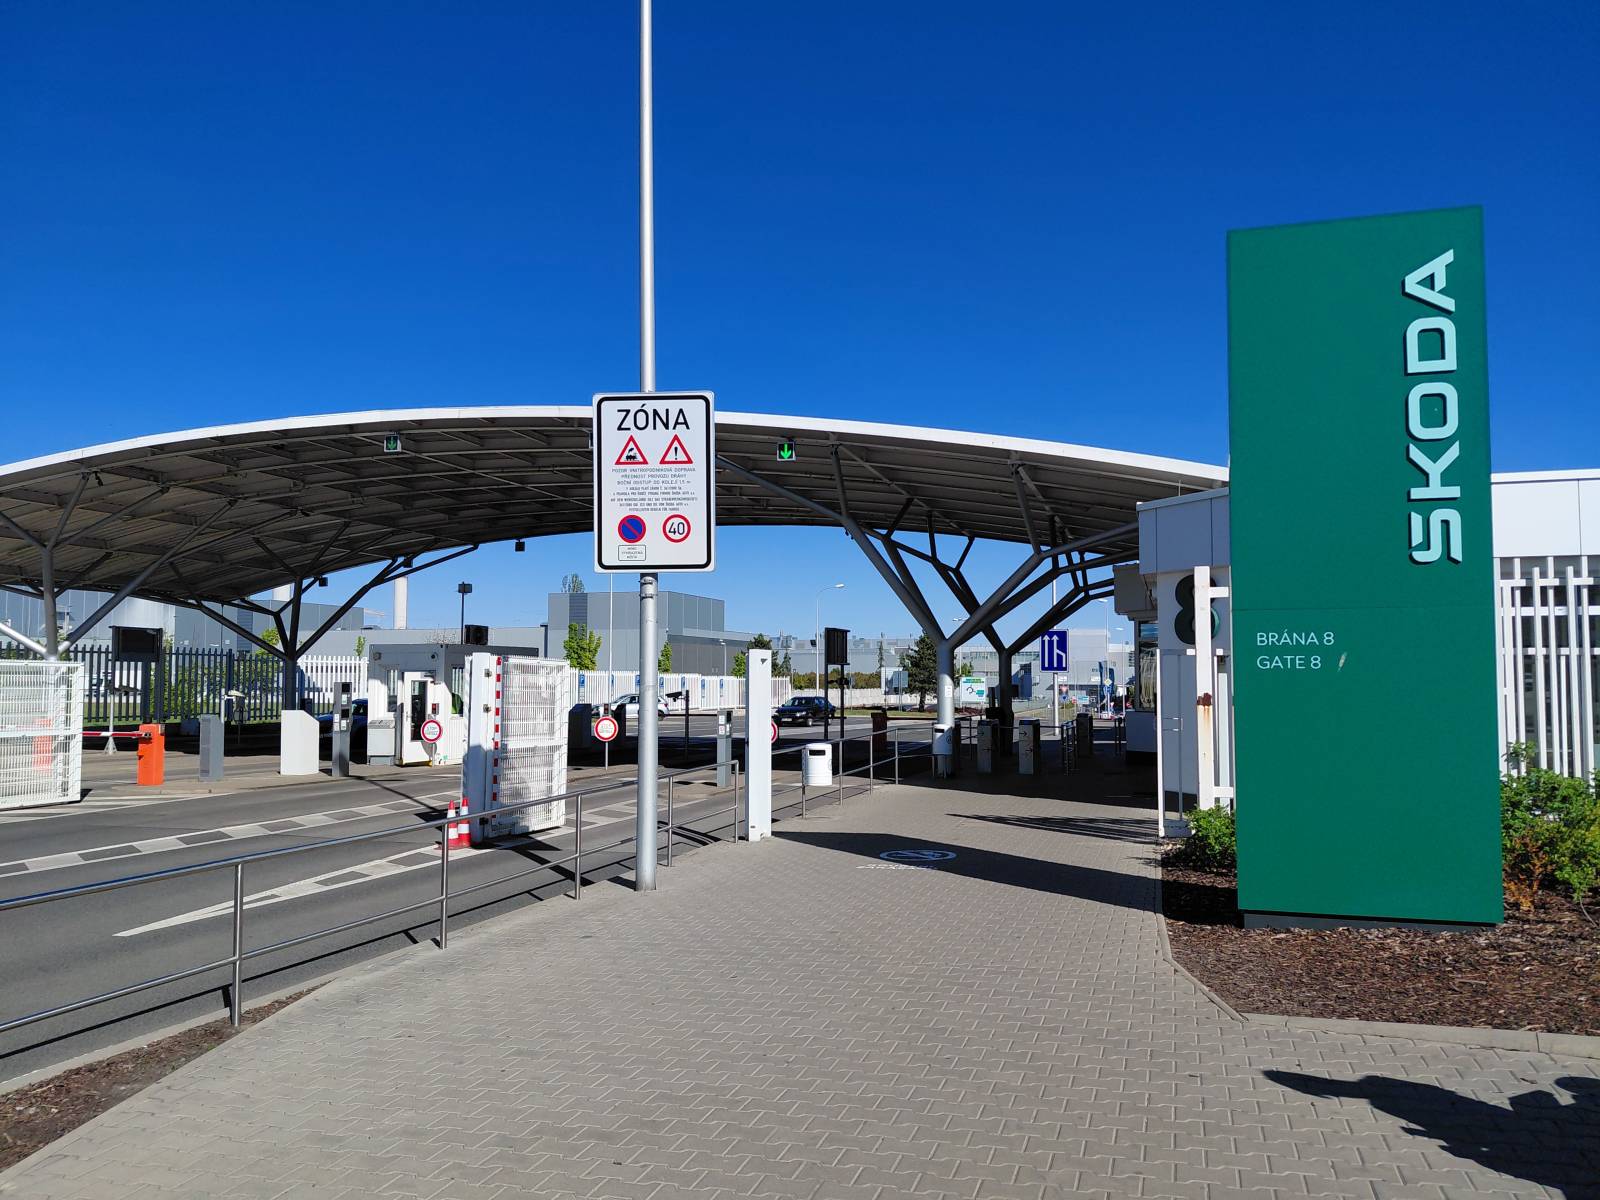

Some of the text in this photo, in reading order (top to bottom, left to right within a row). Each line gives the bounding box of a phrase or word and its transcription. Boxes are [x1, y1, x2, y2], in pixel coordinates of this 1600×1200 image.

[617, 403, 690, 431] ZÓNA
[668, 521, 685, 536] 40
[1256, 629, 1335, 646] BRÁNA 8
[1256, 656, 1322, 670] GATE 8
